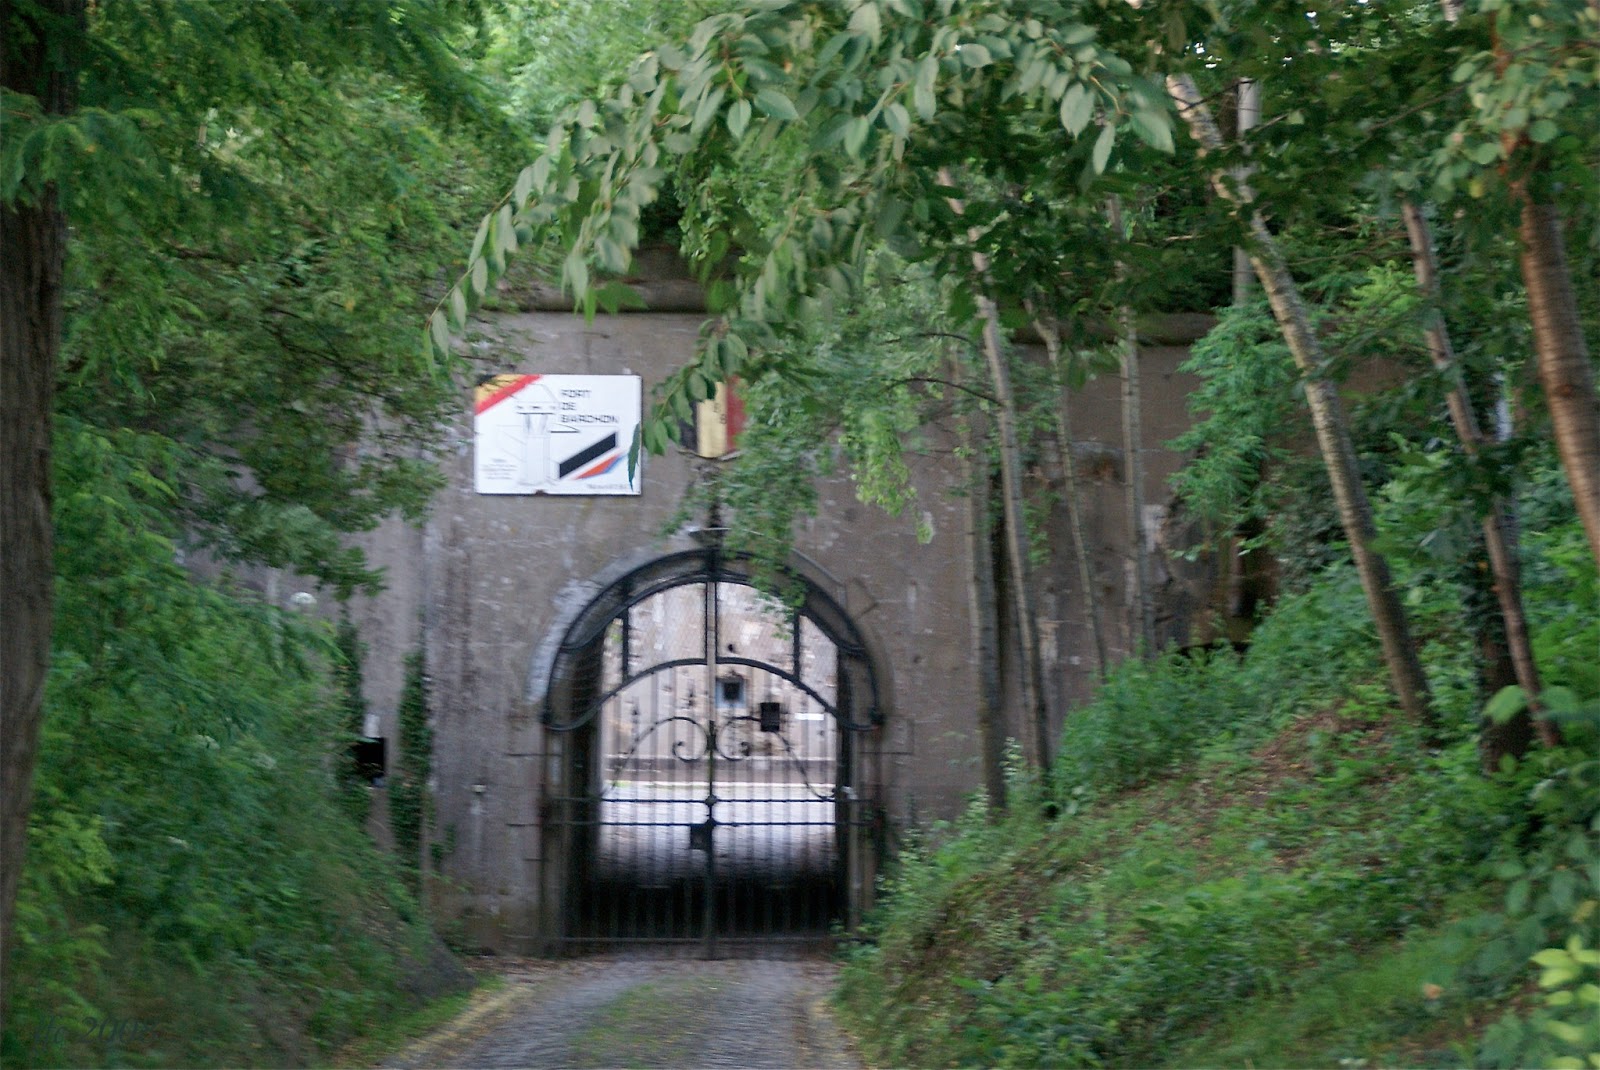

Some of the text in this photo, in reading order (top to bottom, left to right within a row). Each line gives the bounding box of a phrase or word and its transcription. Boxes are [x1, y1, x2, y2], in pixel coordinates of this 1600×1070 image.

[561, 388, 590, 399] FORT
[561, 401, 577, 411] DE
[561, 414, 619, 424] BARCHON
